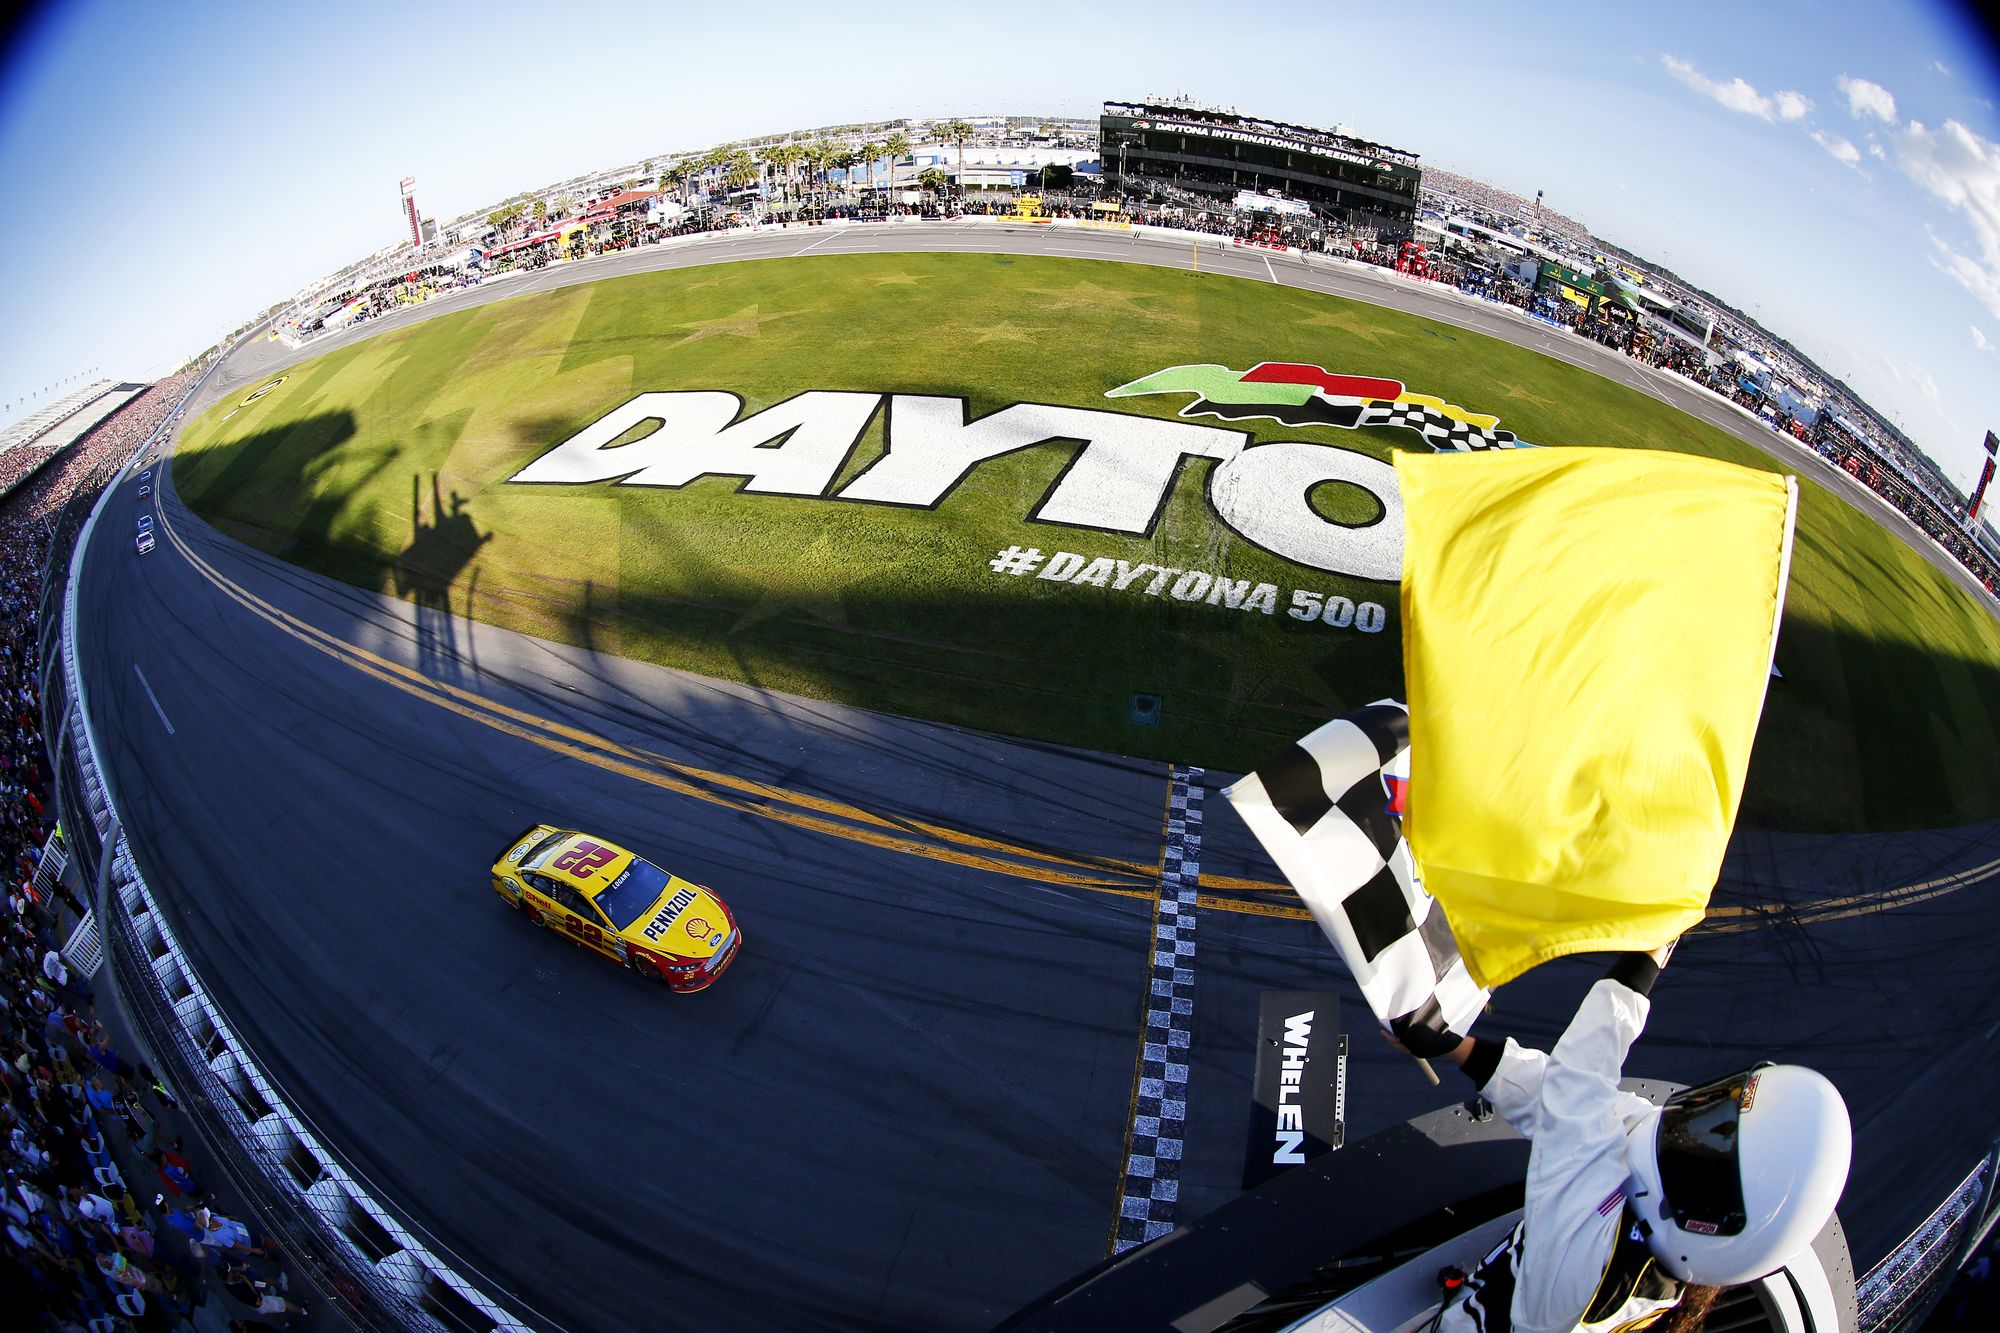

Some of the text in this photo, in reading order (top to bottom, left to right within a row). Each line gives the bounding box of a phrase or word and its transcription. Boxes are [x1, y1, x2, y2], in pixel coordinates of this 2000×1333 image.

[1155, 122, 1373, 167] DAYTONA INTERNATIONAL SPEEDWAY
[1610, 307, 1627, 319] Sprint
[503, 390, 1403, 583] DAYTO
[989, 545, 1386, 634] #DAYTONA 500
[553, 841, 619, 879] 22
[612, 871, 631, 890] LOGANO
[525, 890, 552, 910] Shell
[643, 888, 698, 942] PENNZOIL
[565, 914, 603, 944] 22
[1273, 1011, 1315, 1164] WHELEN
